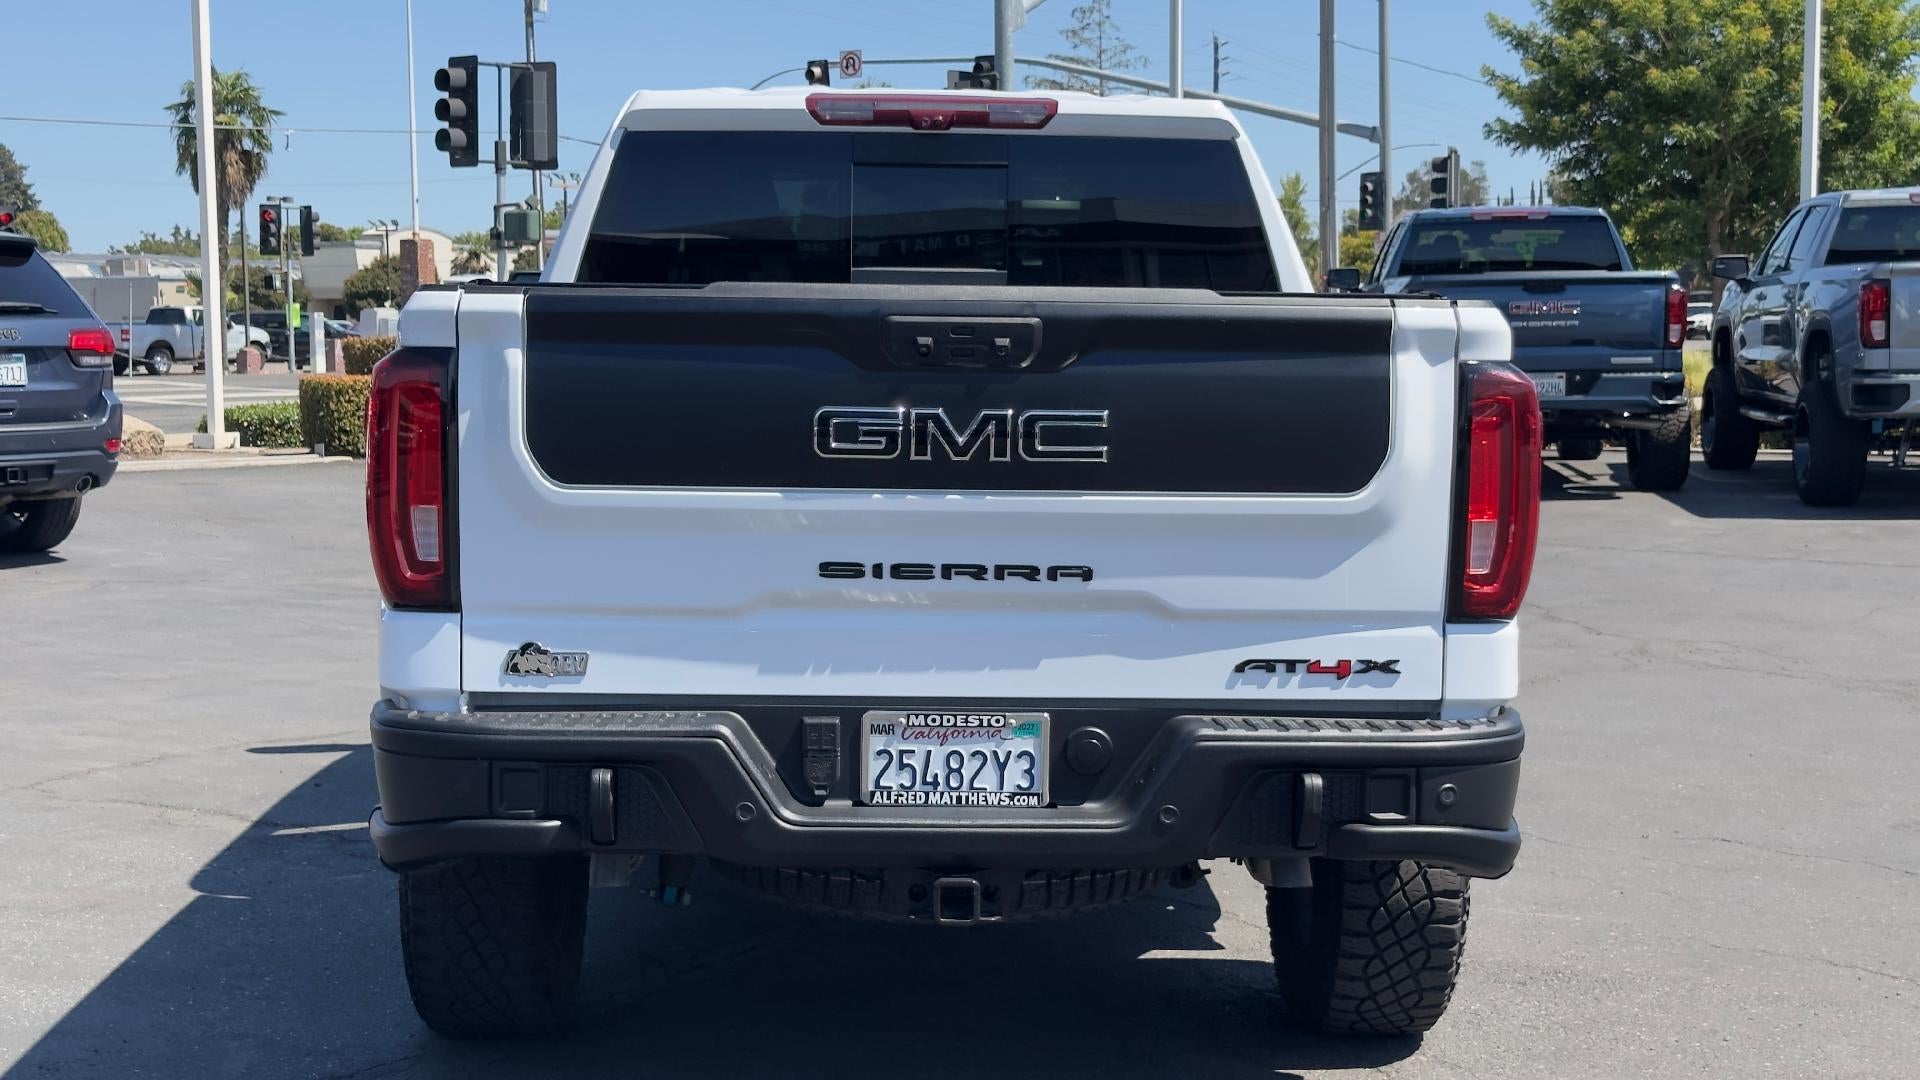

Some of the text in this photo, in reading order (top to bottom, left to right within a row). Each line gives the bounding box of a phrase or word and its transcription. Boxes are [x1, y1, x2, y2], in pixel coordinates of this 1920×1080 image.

[1509, 300, 1580, 314] GMC
[813, 406, 1108, 462] GMC
[818, 561, 1094, 582] SIERRA
[1233, 659, 1402, 681] AT4X
[870, 723, 895, 735] MAR
[908, 714, 1005, 727] MODESTO
[1017, 723, 1035, 731] 2027
[901, 726, 1013, 746] California
[874, 748, 1036, 791] 25482Y3
[872, 792, 1038, 806] ALFRED MATTHEWS.COM
